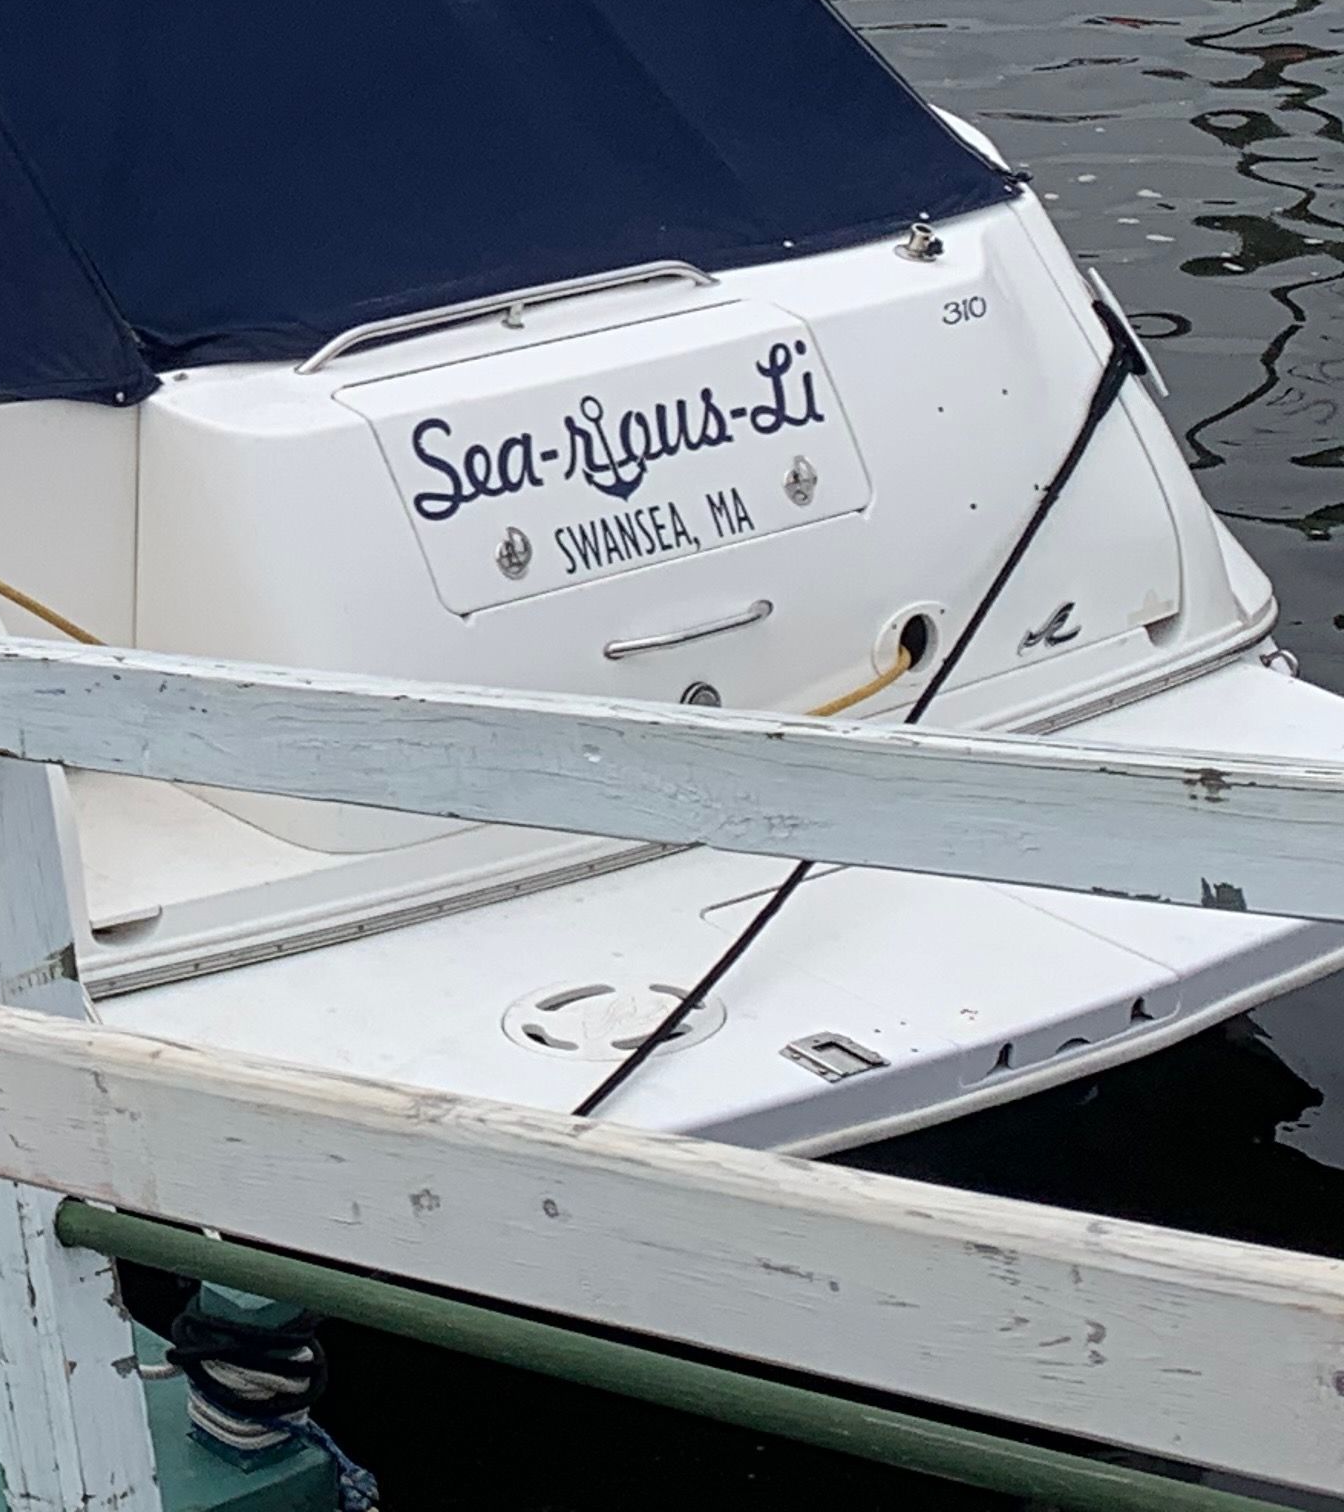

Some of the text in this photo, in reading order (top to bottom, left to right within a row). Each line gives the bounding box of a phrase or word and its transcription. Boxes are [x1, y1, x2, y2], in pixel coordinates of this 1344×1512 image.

[941, 296, 987, 326] 310
[554, 487, 755, 575] SWANSEA, MA
